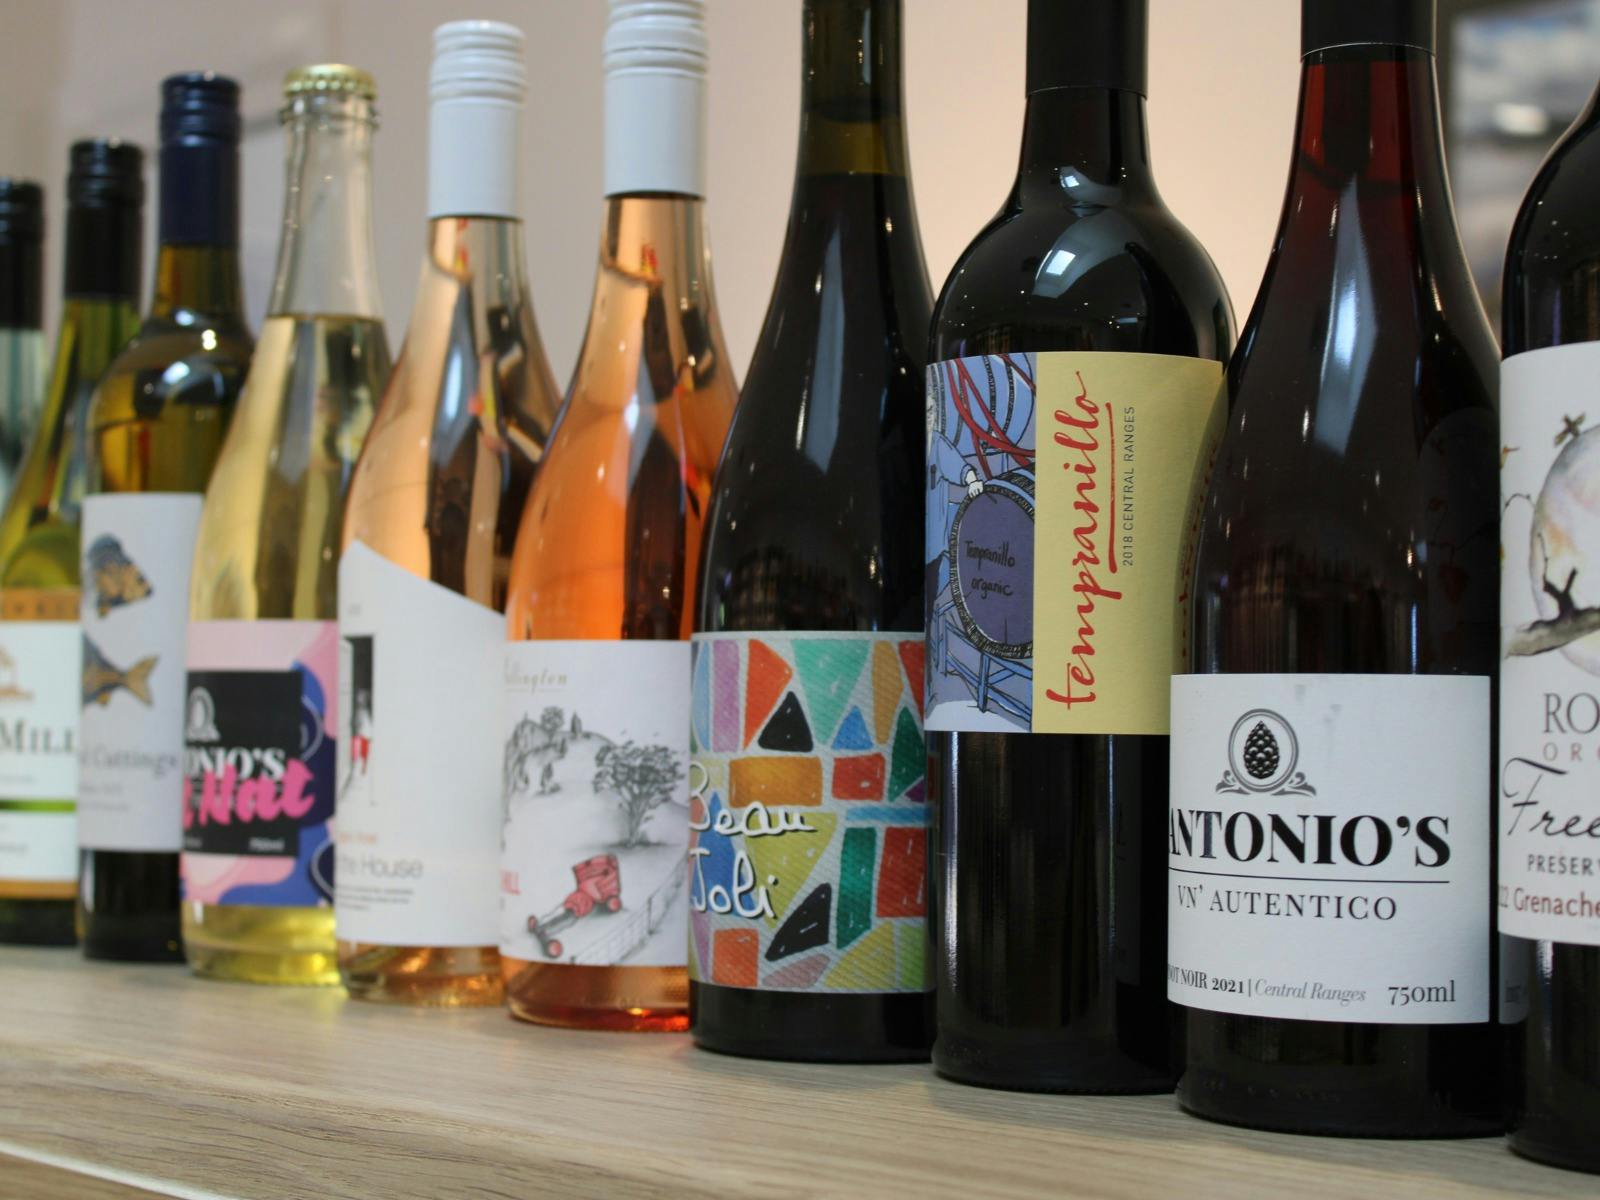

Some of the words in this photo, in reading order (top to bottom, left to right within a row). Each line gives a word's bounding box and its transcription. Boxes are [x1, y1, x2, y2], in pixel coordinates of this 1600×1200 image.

[1124, 406, 1136, 462] RANGES
[1123, 468, 1135, 531] CENTRAL
[1046, 371, 1122, 710] tempranillo
[1122, 536, 1134, 567] 2018
[971, 577, 1014, 600] organic
[1543, 742, 1600, 762] OR
[360, 853, 424, 879] House
[1527, 853, 1600, 877] PRESER
[689, 848, 777, 919] Joli
[1210, 889, 1397, 921] AUTENTICO
[1181, 968, 1208, 989] NOIR
[1212, 977, 1244, 994] 2021
[1255, 978, 1307, 999] Central
[1310, 982, 1367, 1007] Ranges
[1389, 980, 1456, 1006] 750ml
